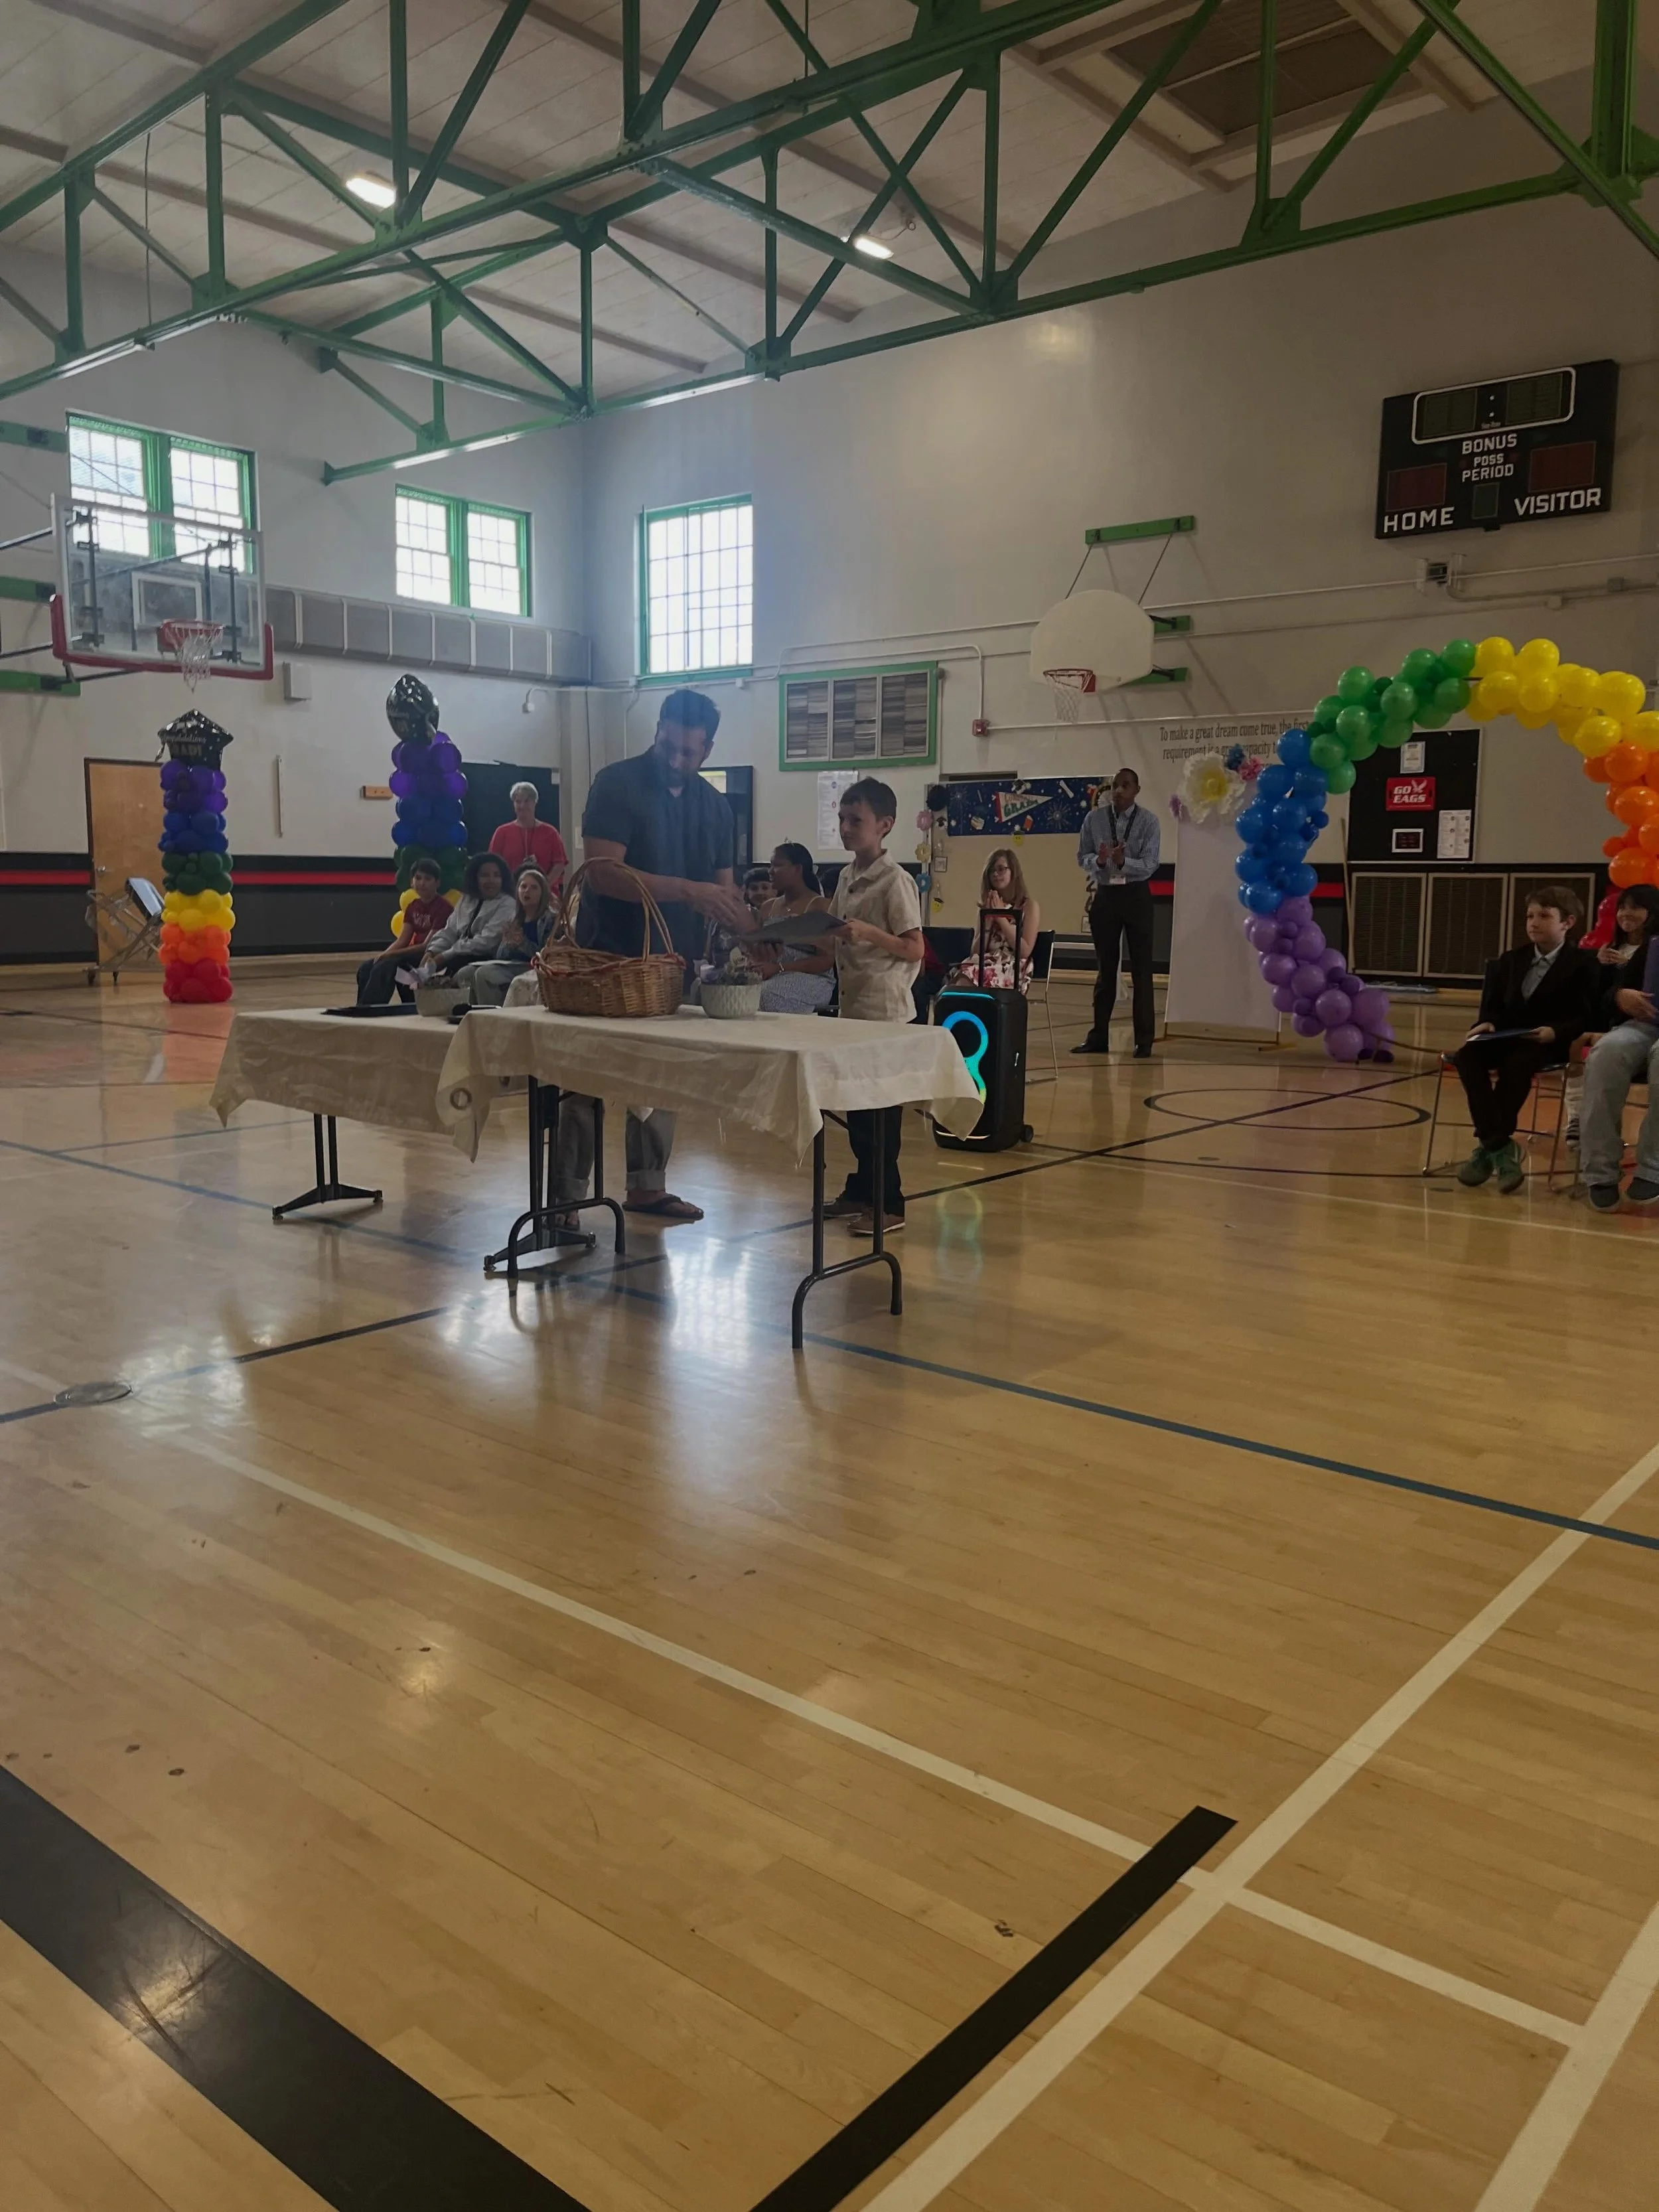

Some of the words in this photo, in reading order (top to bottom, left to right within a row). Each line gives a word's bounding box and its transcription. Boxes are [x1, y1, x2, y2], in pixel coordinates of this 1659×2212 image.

[1462, 433, 1518, 455] BONUS
[1474, 453, 1504, 467] POSS
[1462, 464, 1514, 482] PERIOD
[1514, 487, 1601, 516] VISITOR
[1384, 506, 1455, 533] HOME
[1160, 727, 1168, 741] To
[1169, 724, 1188, 741] make
[1190, 728, 1194, 739] a
[1195, 727, 1214, 743] great
[1215, 722, 1238, 738] dream
[1240, 724, 1260, 737] come
[1261, 721, 1278, 737] true,
[1163, 745, 1206, 763] requirement
[1393, 794, 1427, 804] EAGS
[1394, 786, 1411, 794] GO
